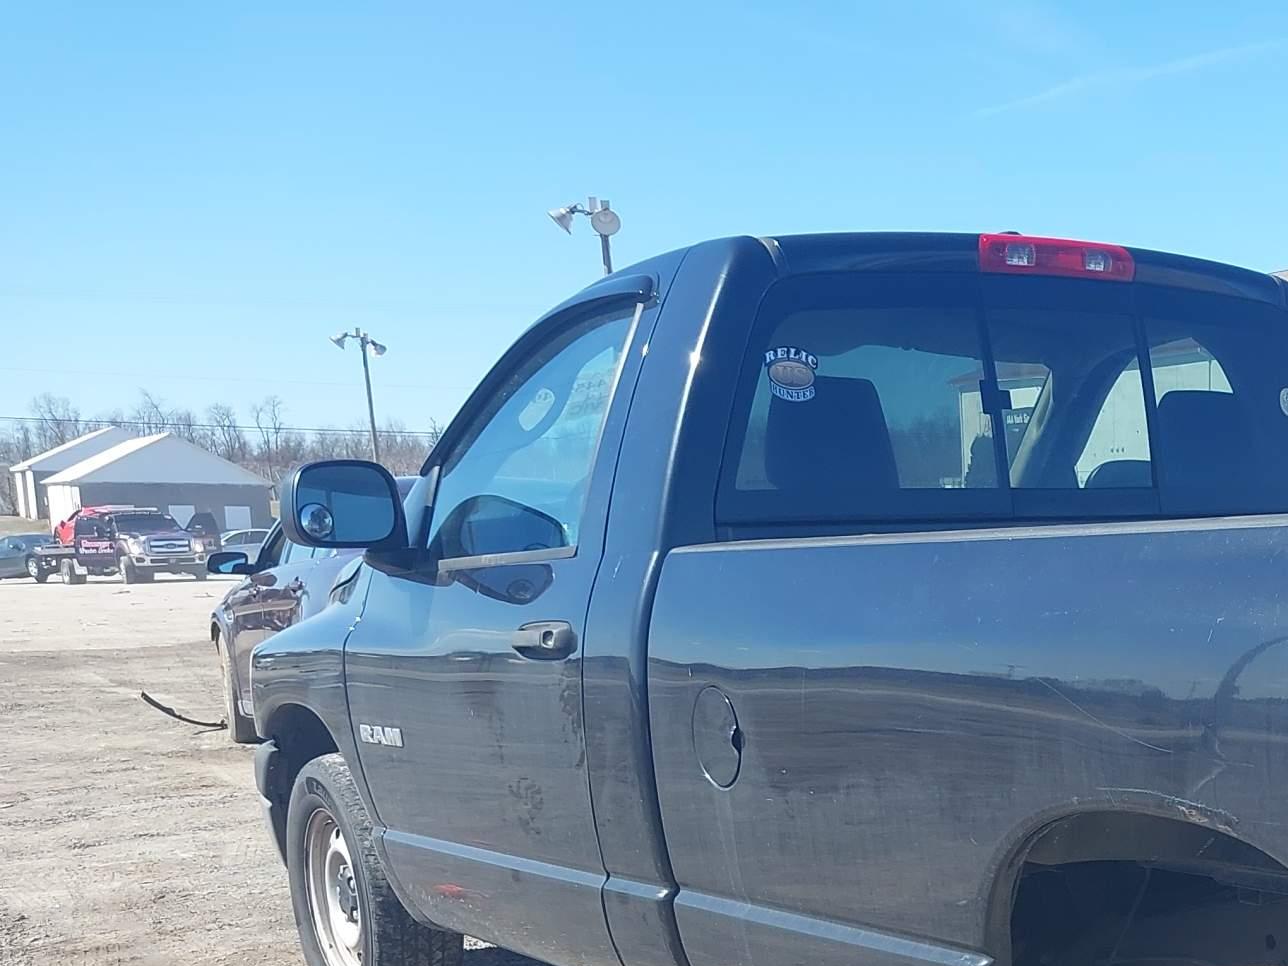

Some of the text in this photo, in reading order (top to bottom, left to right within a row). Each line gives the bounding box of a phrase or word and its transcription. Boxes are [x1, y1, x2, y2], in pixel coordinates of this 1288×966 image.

[765, 347, 817, 369] RELIC
[770, 381, 816, 402] HUNTER
[360, 723, 404, 747] RAM
